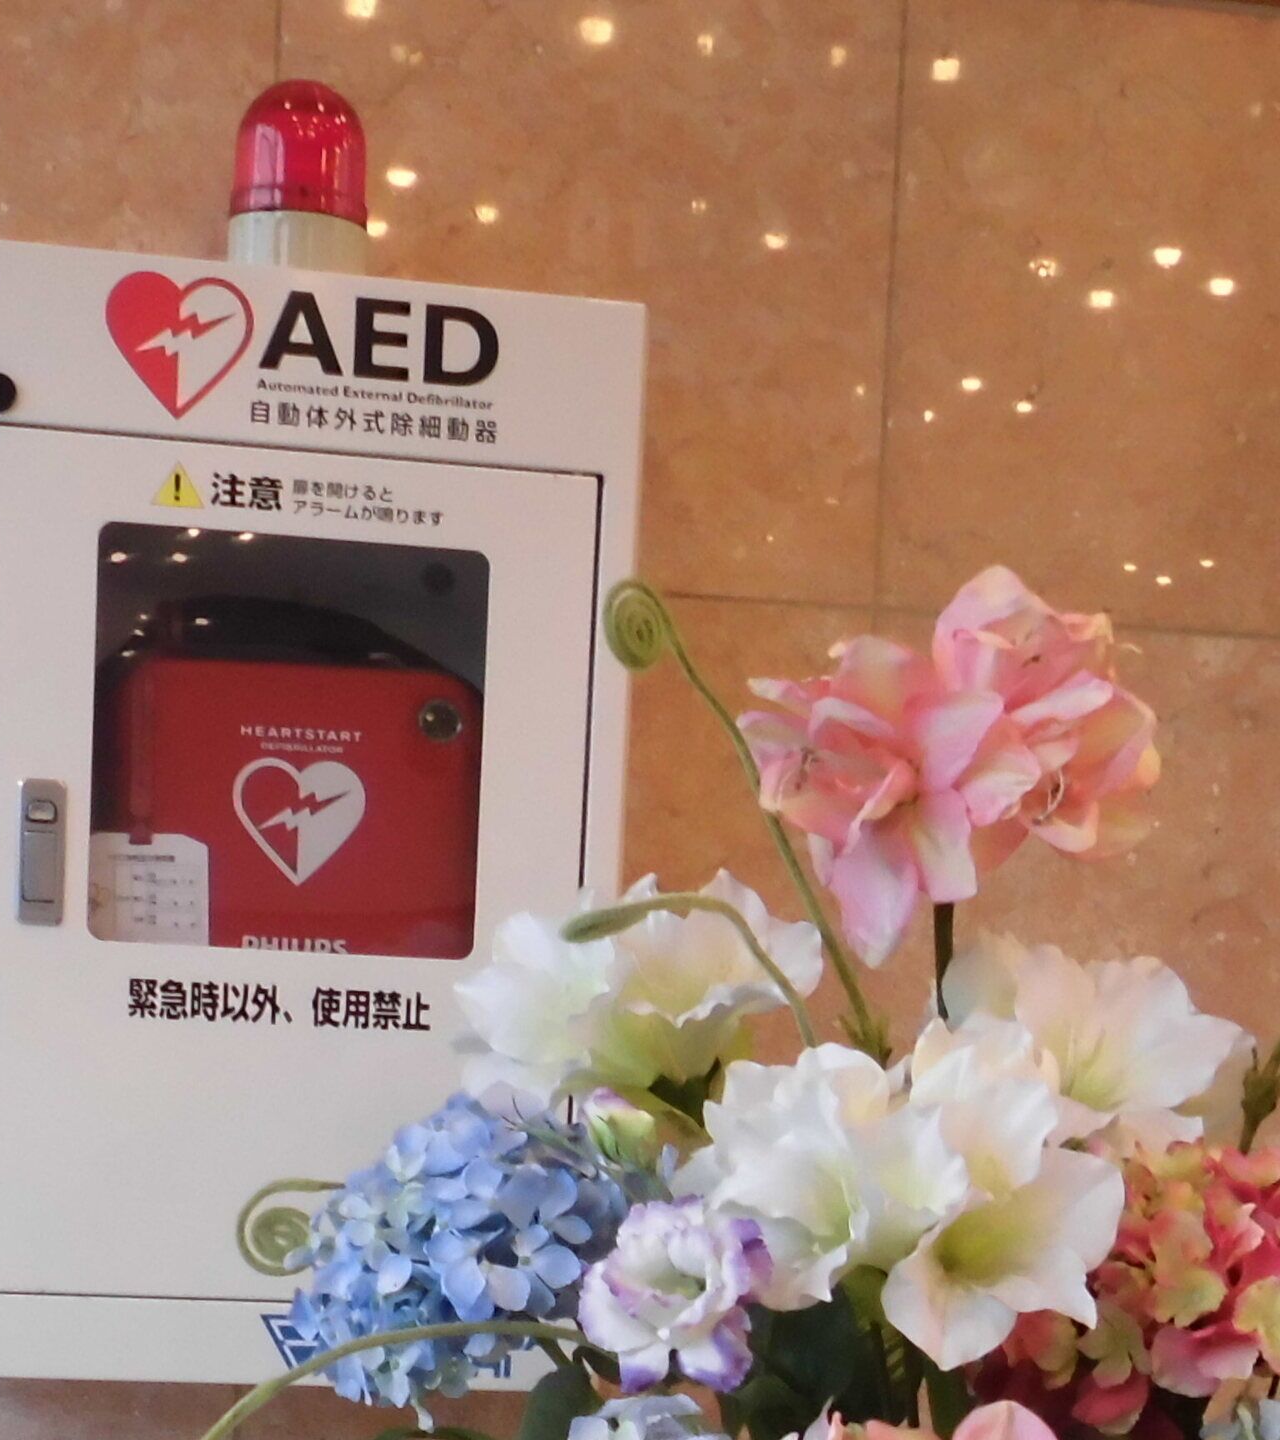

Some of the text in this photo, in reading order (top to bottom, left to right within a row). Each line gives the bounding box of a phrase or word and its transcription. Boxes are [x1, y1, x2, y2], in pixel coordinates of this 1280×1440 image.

[259, 290, 500, 387] AED
[257, 378, 494, 411] Automated External Defibrillator
[250, 399, 498, 445] 自動体外式除細動器
[211, 471, 283, 511] 注意
[293, 478, 394, 503] 扉を開けると
[293, 500, 445, 526] アラームが鳴ります
[240, 724, 363, 743] HEARTSTART
[128, 978, 431, 1031] 緊急時以外、使用禁止
